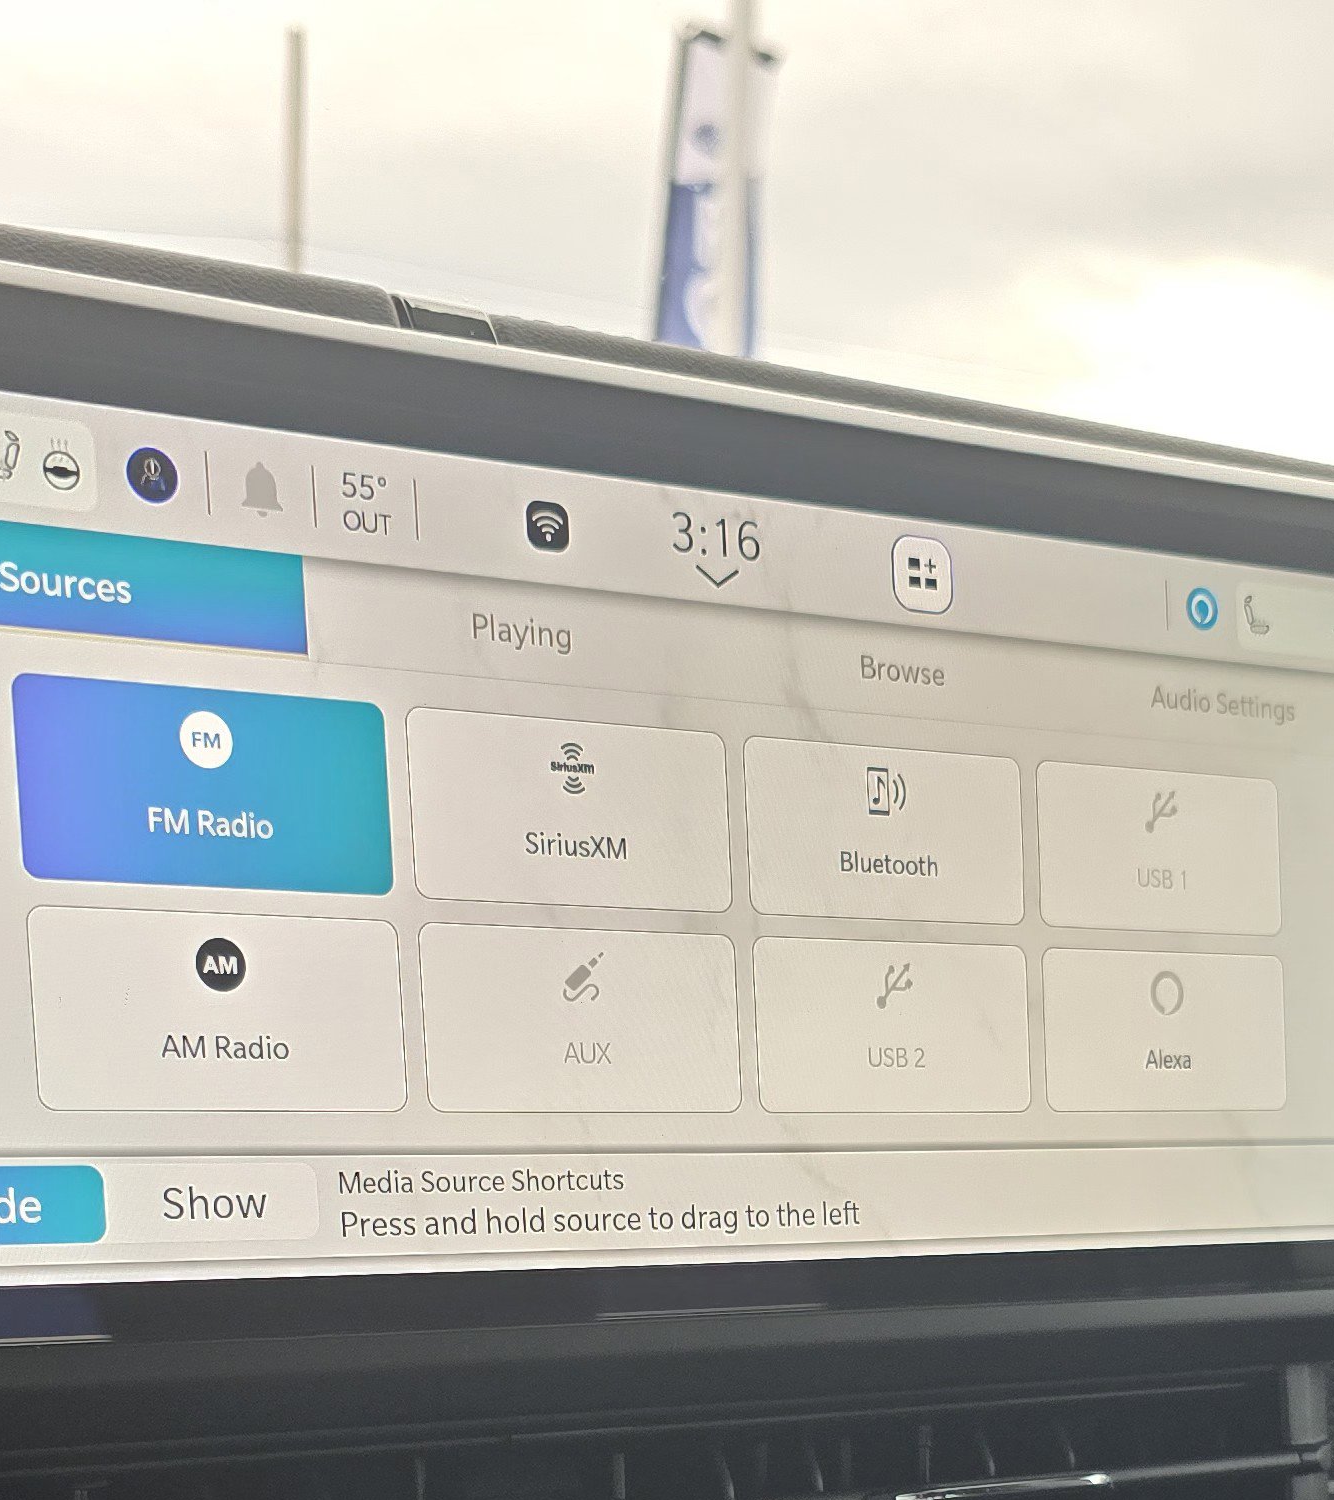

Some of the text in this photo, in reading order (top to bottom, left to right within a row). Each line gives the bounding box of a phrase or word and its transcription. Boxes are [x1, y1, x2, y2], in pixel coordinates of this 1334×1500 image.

[342, 509, 391, 537] OUT
[671, 510, 761, 563] 3:16
[471, 612, 573, 655] Playing
[860, 654, 946, 688] Browse
[1151, 685, 1296, 726] Audio Settings
[190, 730, 221, 751] FM
[146, 806, 274, 840] FM Radio
[524, 830, 628, 861] SiriusXM
[839, 850, 939, 878] Bluetooth
[1137, 868, 1188, 891] USB 1
[202, 954, 239, 977] AM
[161, 1034, 291, 1062] AM Radio
[563, 1041, 612, 1066] AUX
[867, 1046, 926, 1069] USB 2
[1145, 1049, 1192, 1071] Alexa
[338, 1168, 625, 1196] Media Source Shortcuts
[162, 1186, 268, 1222] Show
[339, 1200, 861, 1239] Press and hold source to drag to the left
